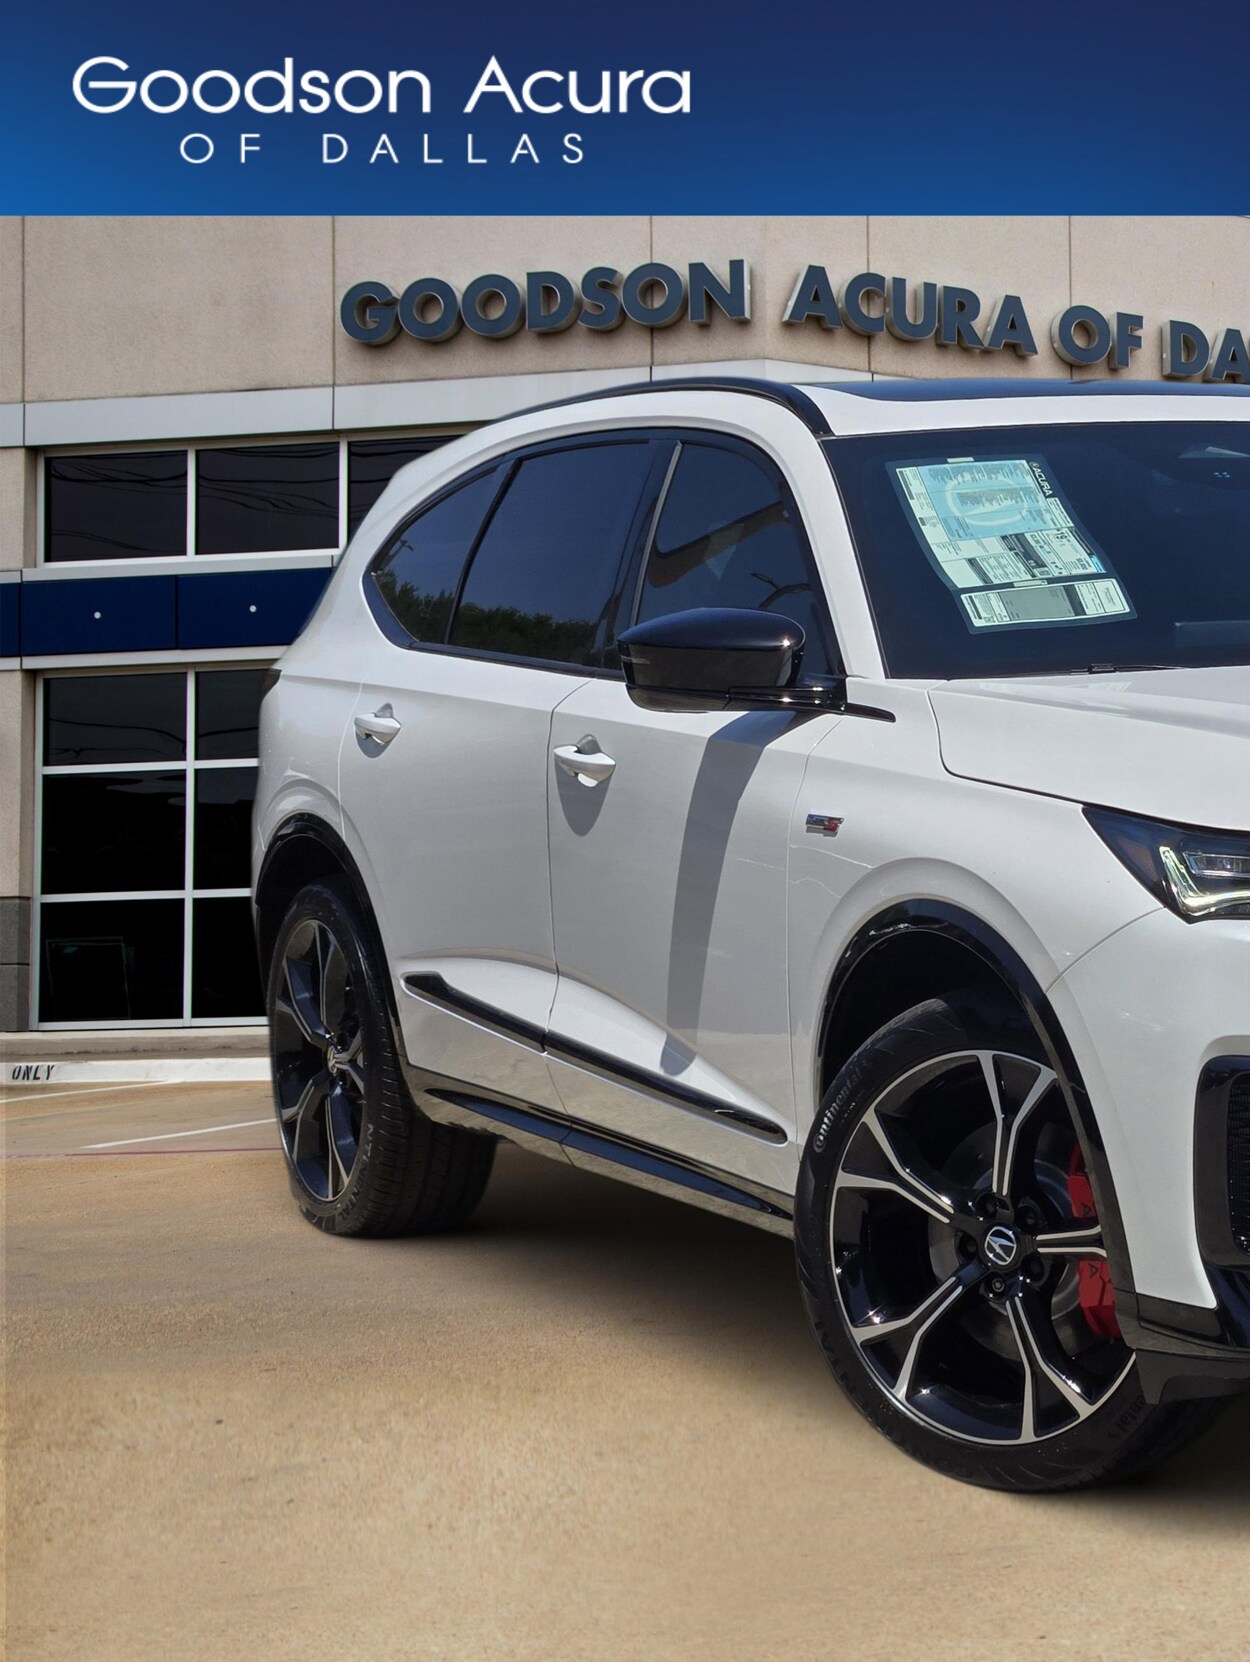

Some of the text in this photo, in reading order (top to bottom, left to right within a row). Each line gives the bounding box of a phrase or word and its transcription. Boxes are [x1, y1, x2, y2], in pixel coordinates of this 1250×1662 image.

[340, 259, 751, 347] GOODSON
[783, 264, 1038, 356] ACURA
[1052, 304, 1144, 370] OF
[1032, 467, 1053, 496] ACURA
[12, 1064, 55, 1081] ONLY
